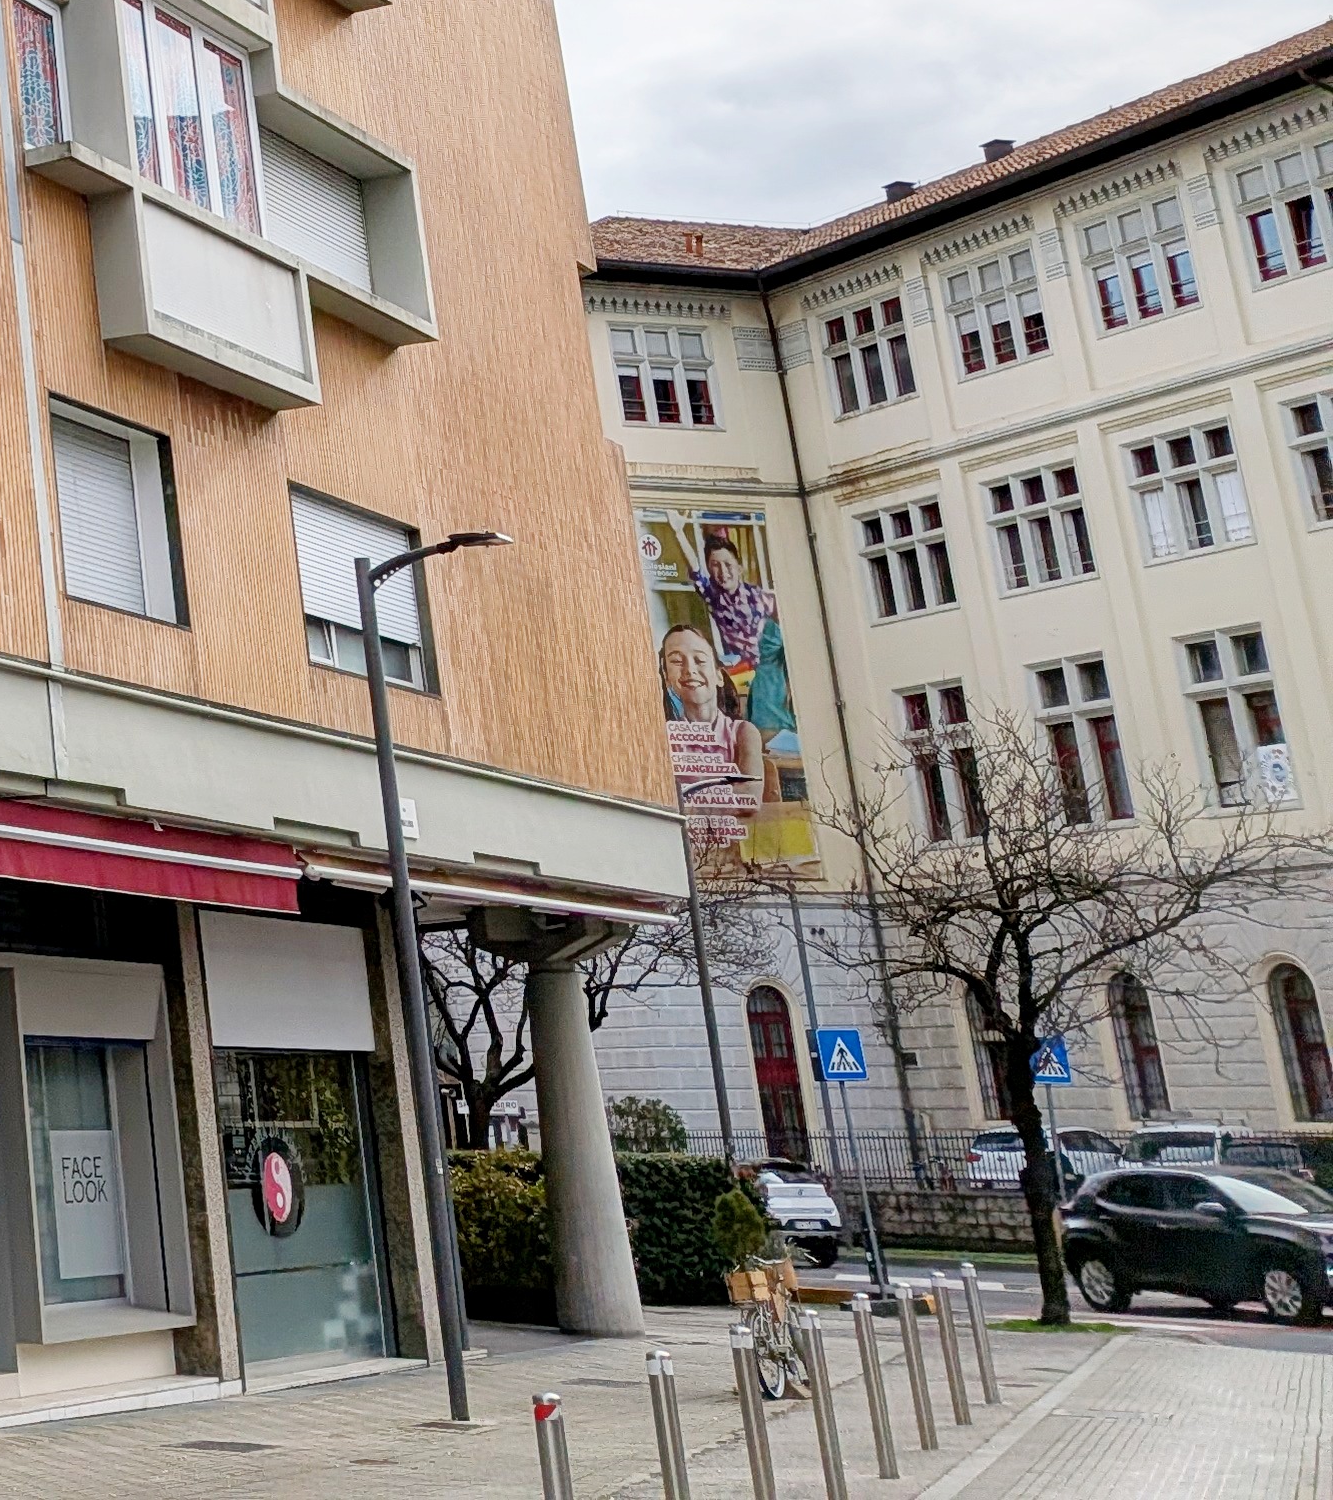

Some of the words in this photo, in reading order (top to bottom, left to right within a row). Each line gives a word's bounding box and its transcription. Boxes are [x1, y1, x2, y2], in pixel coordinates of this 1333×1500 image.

[668, 723, 691, 733] CASA
[692, 723, 711, 733] CHE
[669, 733, 716, 743] ACCOGLIE
[671, 754, 703, 764] CHIESA
[704, 755, 722, 765] CHE
[673, 764, 739, 774] EVANGELIZZA
[713, 787, 732, 796] CHE
[710, 796, 735, 806] ALLA
[735, 797, 757, 807] VITA
[61, 1156, 103, 1180] FACE
[63, 1180, 109, 1204] LOOK
